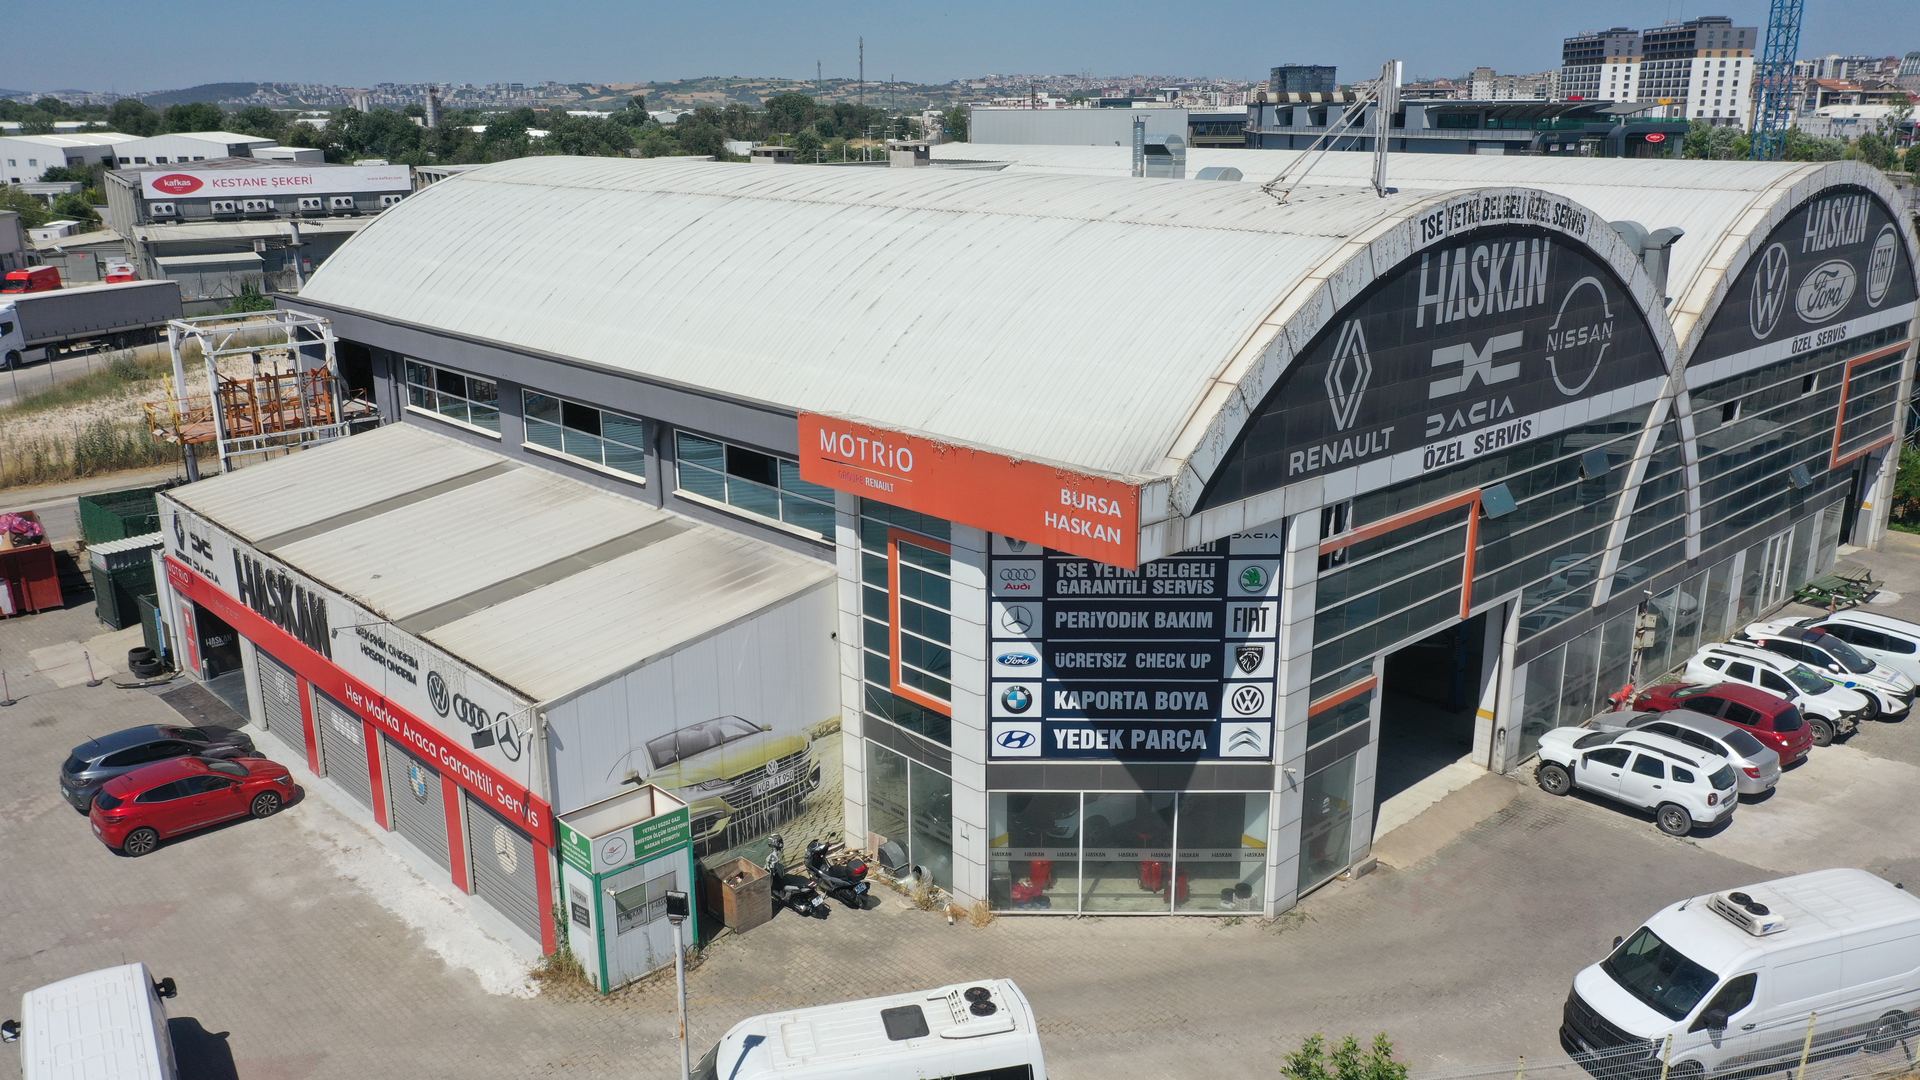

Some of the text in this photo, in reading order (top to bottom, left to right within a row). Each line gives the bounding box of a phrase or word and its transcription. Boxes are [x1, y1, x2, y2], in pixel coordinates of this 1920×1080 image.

[163, 179, 192, 187] kafkas
[212, 174, 313, 189] KESTANE ŞEKERİ
[1420, 210, 1443, 243] TSE
[1552, 207, 1587, 236] SERVİS
[1801, 194, 1872, 254] HASKAN
[1416, 237, 1551, 329] HASKAN
[1806, 269, 1848, 313] Ford
[1546, 320, 1614, 353] NISSAN
[1791, 324, 1847, 355] ÖZEL SERVİS
[1425, 395, 1515, 438] DACIA
[1288, 426, 1395, 477] RENAULT
[1423, 419, 1533, 471] ÖZEL SERVİS
[865, 477, 894, 493] RENAULT
[1060, 488, 1122, 519] BURSA
[1044, 510, 1121, 545] HASKAN
[1056, 562, 1088, 578] TSE
[1004, 582, 1031, 590] Audi
[232, 547, 333, 662] HASKAN
[1154, 611, 1213, 629] BAKIM
[1233, 606, 1270, 633] FIAT
[1004, 655, 1030, 665] Ford
[1135, 652, 1187, 669] CHECK
[1190, 653, 1212, 669] UP
[1054, 690, 1209, 711] KAPORTA BOYA
[344, 682, 540, 828] Her Marka Araca Garantili Servis
[1053, 729, 1208, 753] YEDEK PARÇA
